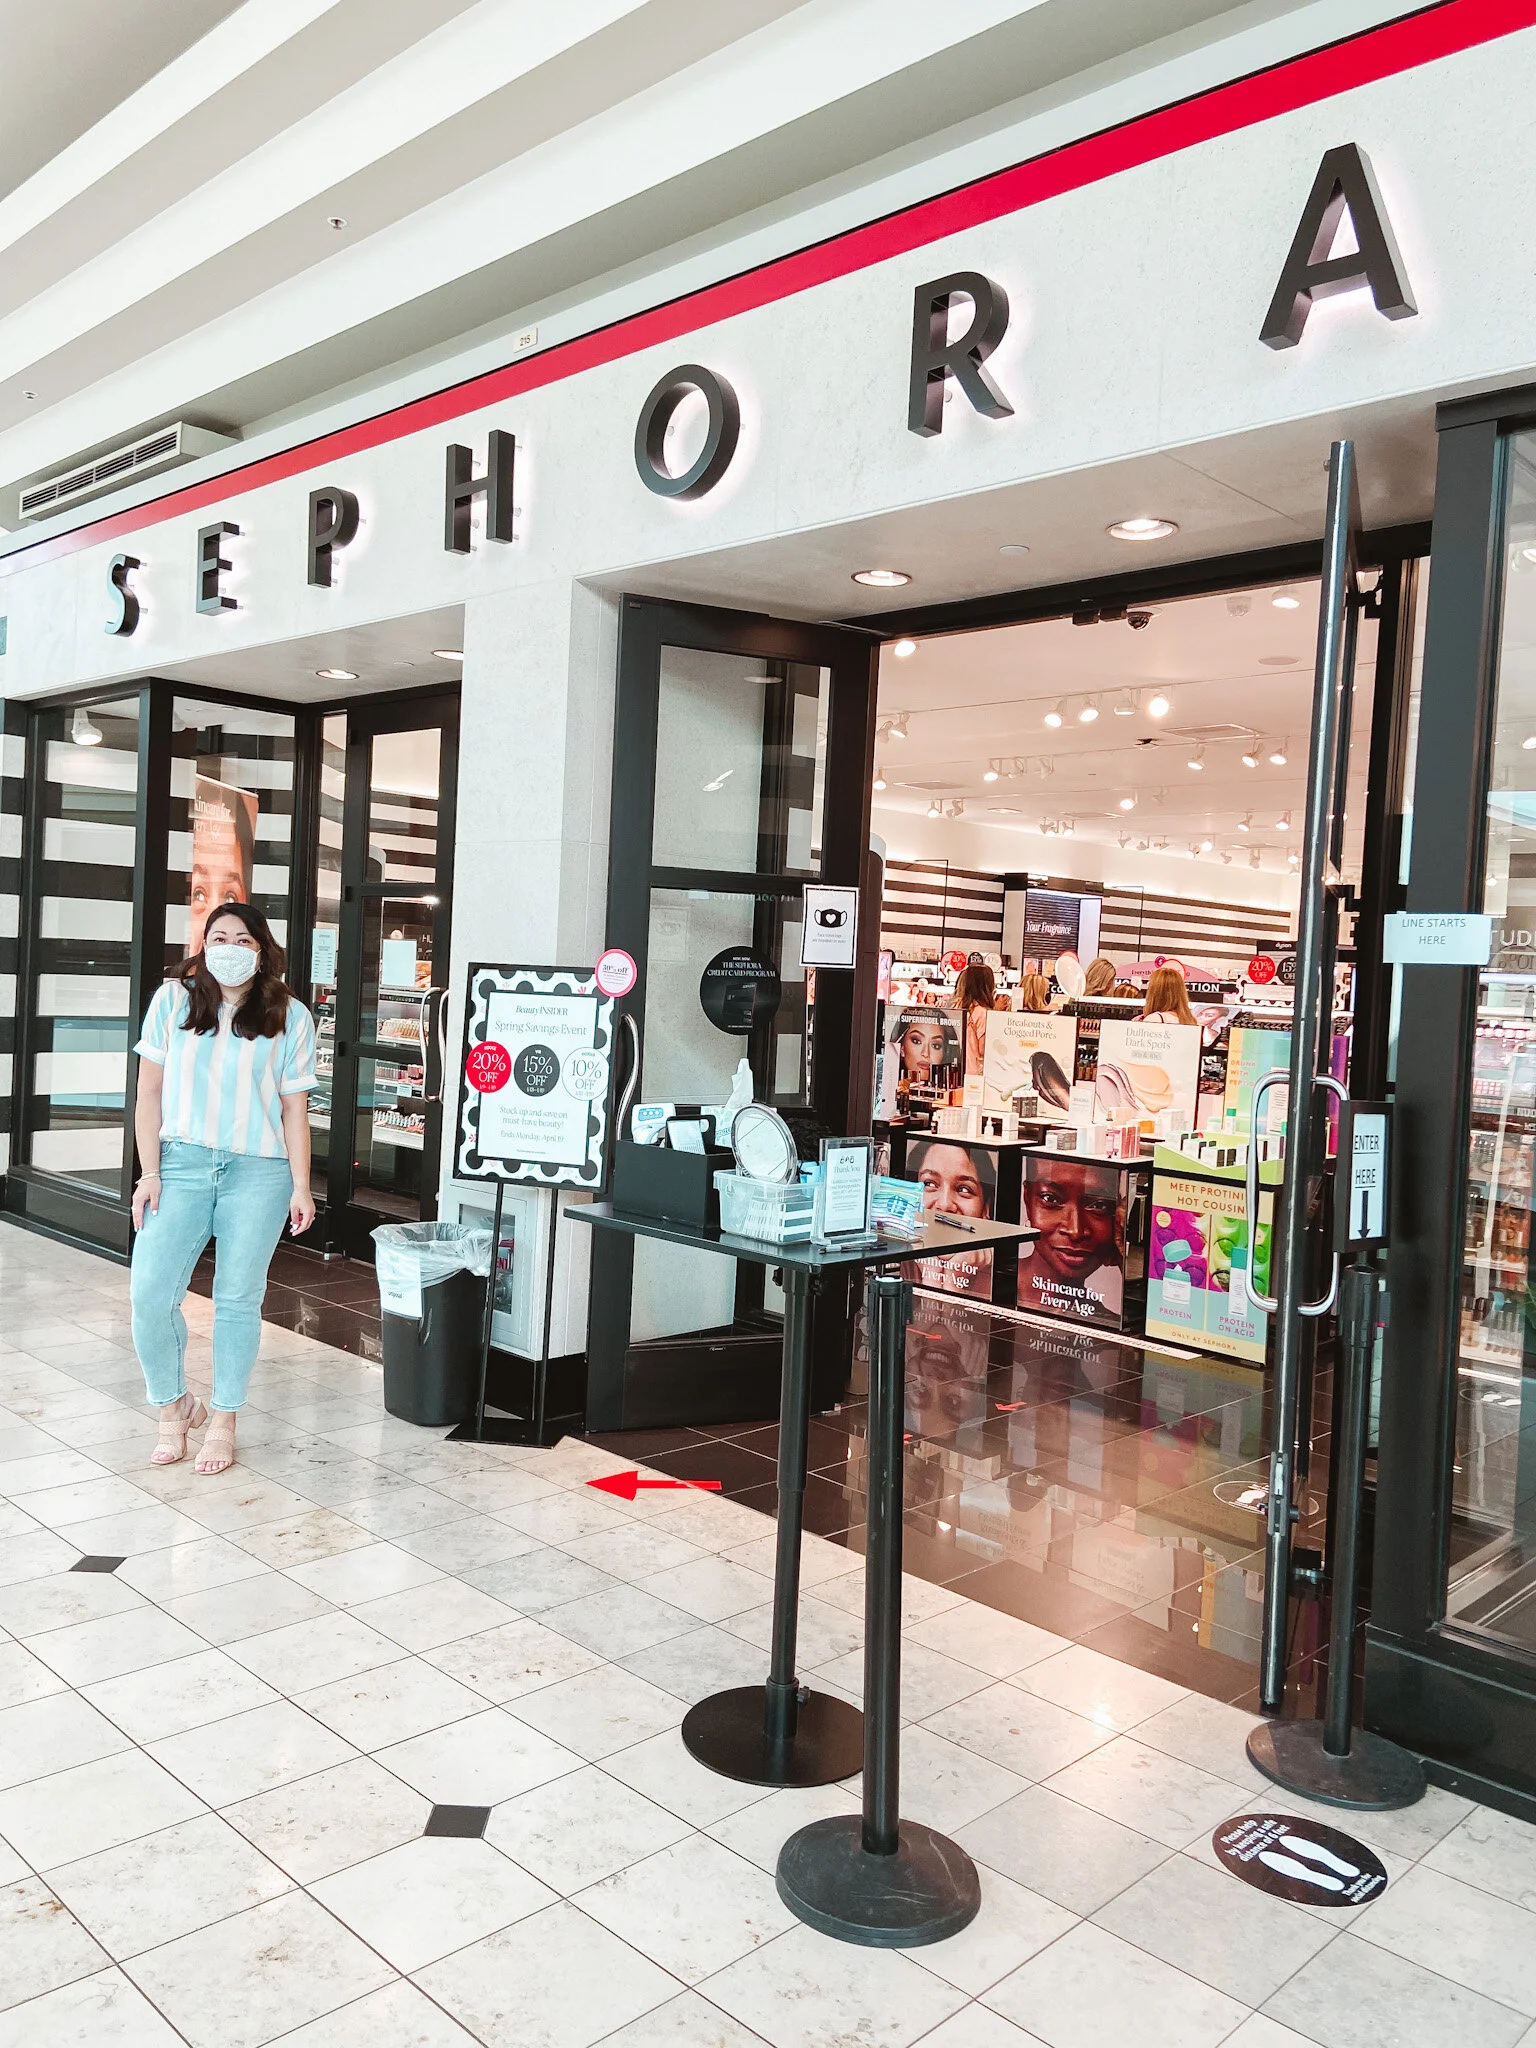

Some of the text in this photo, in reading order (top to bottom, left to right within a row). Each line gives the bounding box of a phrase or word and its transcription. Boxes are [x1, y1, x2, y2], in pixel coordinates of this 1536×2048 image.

[519, 335, 530, 346] 215
[105, 143, 1418, 637] SEPHORA
[1026, 921, 1072, 936] Your Fragrance
[1402, 919, 1466, 927] LINE STARTS
[1419, 936, 1446, 945] HERE
[1251, 961, 1273, 971] 20%
[901, 1015, 939, 1024] SUPERMODEL
[940, 1018, 961, 1026] BROWS
[1007, 1018, 1053, 1030] Breakouts &
[495, 1021, 587, 1036] Spring Savings Event
[1004, 1029, 1056, 1039] Clogged Pores
[1126, 1027, 1171, 1039] Dullness &
[1125, 1037, 1171, 1050] Dark Spots
[472, 1052, 506, 1071] 20%
[523, 1055, 553, 1074] 15%
[571, 1059, 602, 1079] 10%
[502, 1117, 564, 1129] must-have beauty!
[542, 1134, 556, 1142] April
[1354, 1135, 1379, 1150] ENTER
[1355, 1168, 1376, 1184] HERE
[1170, 1182, 1245, 1200] MEET PROTINI
[1177, 1196, 1199, 1206] HOT
[962, 1260, 978, 1275] for
[922, 1267, 970, 1288] Every Age
[1031, 1275, 1106, 1303] Skincare for
[1040, 1292, 1096, 1316] Every Age
[1159, 1307, 1192, 1320] PROTEIN
[1219, 1316, 1255, 1329] PROTEIN
[1218, 1324, 1255, 1338] ON ACID
[1172, 1331, 1190, 1341] ONLY
[1203, 1338, 1237, 1351] SEPHORA
[1220, 1820, 1258, 1844] Please help
[1261, 1820, 1278, 1831] safe
[1232, 1831, 1264, 1849] keeping
[1239, 1841, 1268, 1862] distance
[1263, 1835, 1274, 1844] of
[1272, 1824, 1290, 1836] feet
[1224, 1847, 1241, 1856] by
